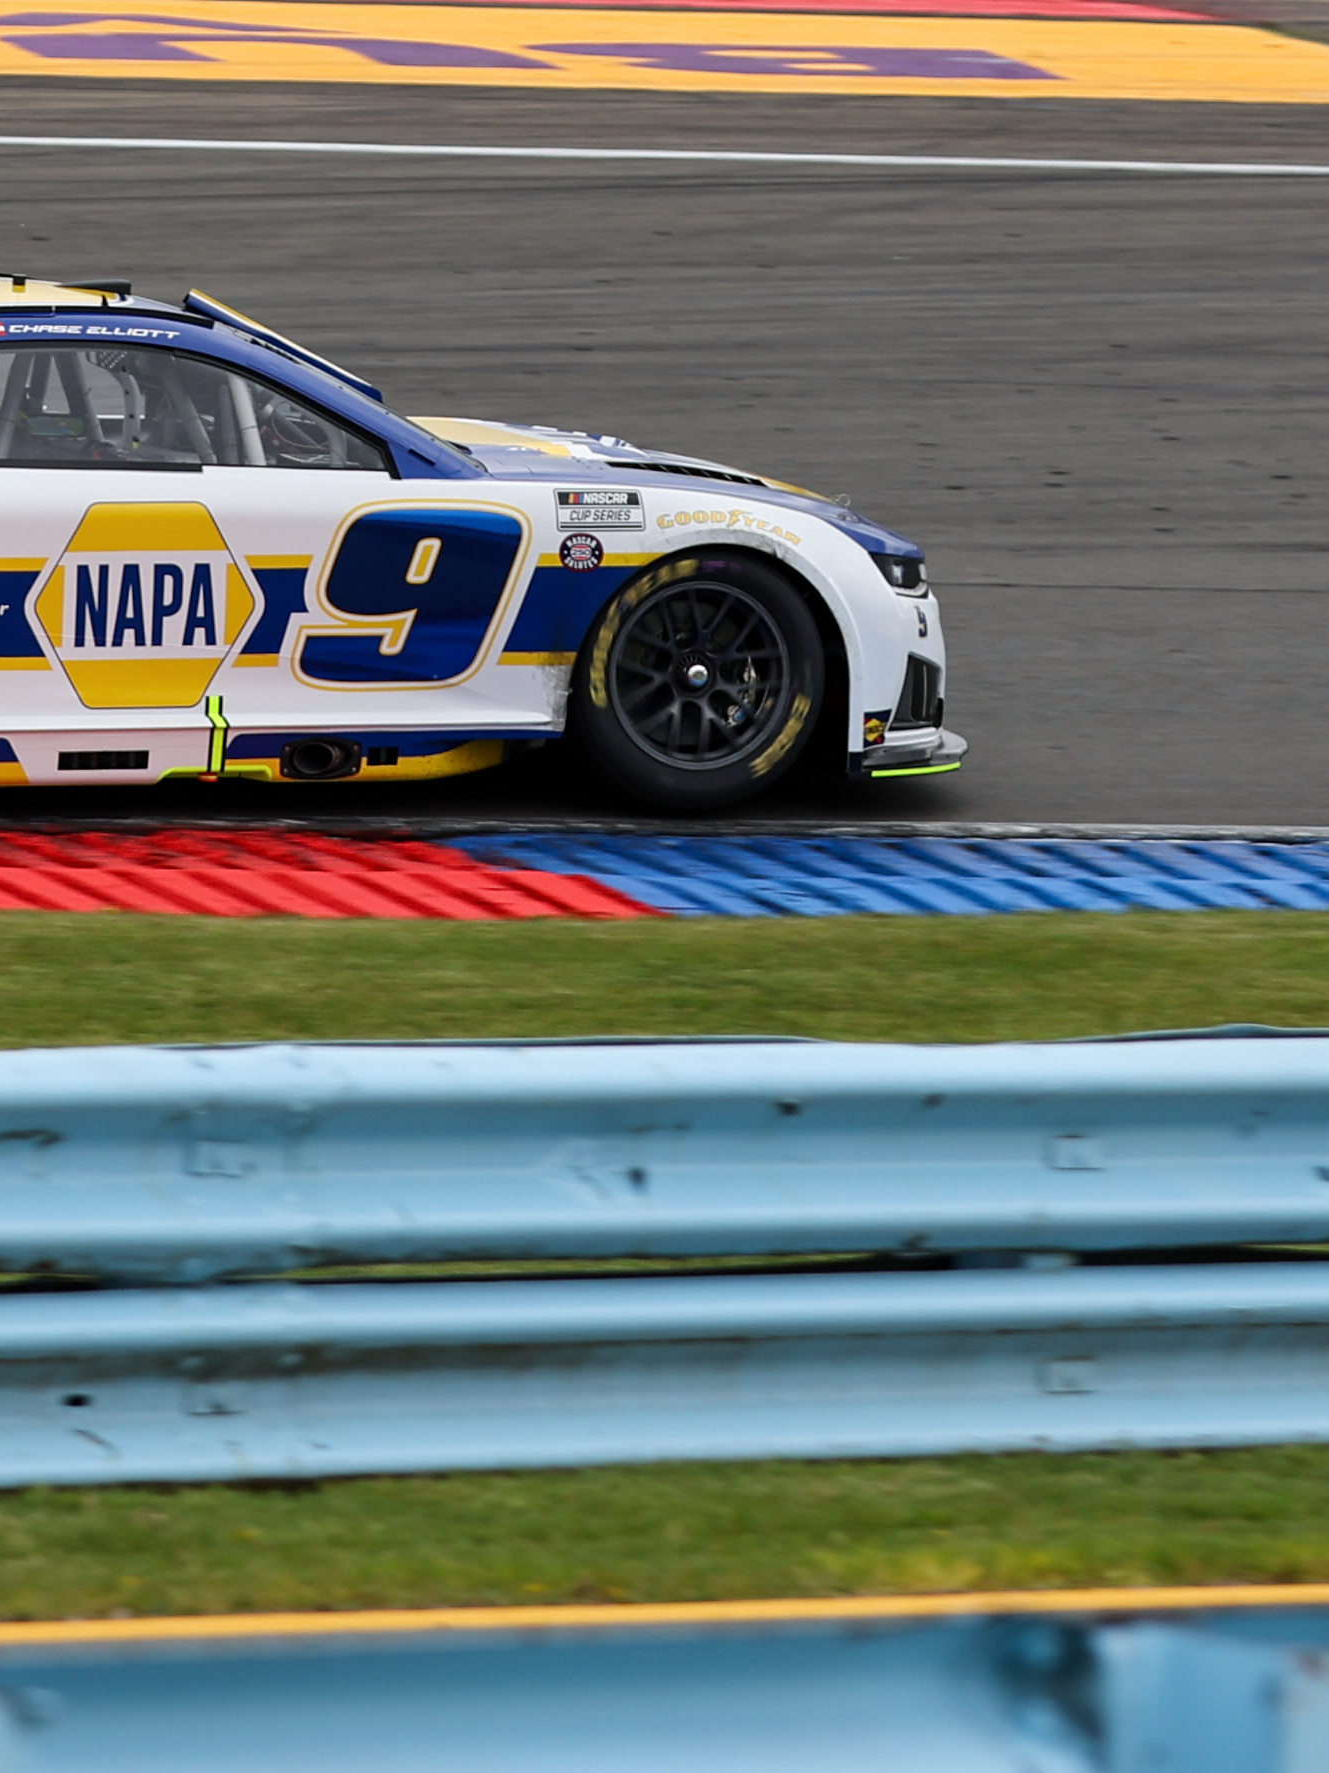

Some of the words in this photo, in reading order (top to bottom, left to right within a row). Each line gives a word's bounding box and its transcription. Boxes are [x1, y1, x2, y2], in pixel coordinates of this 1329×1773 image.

[8, 324, 82, 334] CHASE
[86, 326, 181, 339] ELLIOTT
[583, 493, 629, 504] NASCAR
[570, 510, 591, 521] CUP
[592, 510, 631, 521] SERIES
[656, 509, 802, 545] GOODYEAR
[74, 563, 217, 647] NAPA
[291, 500, 532, 691] 9
